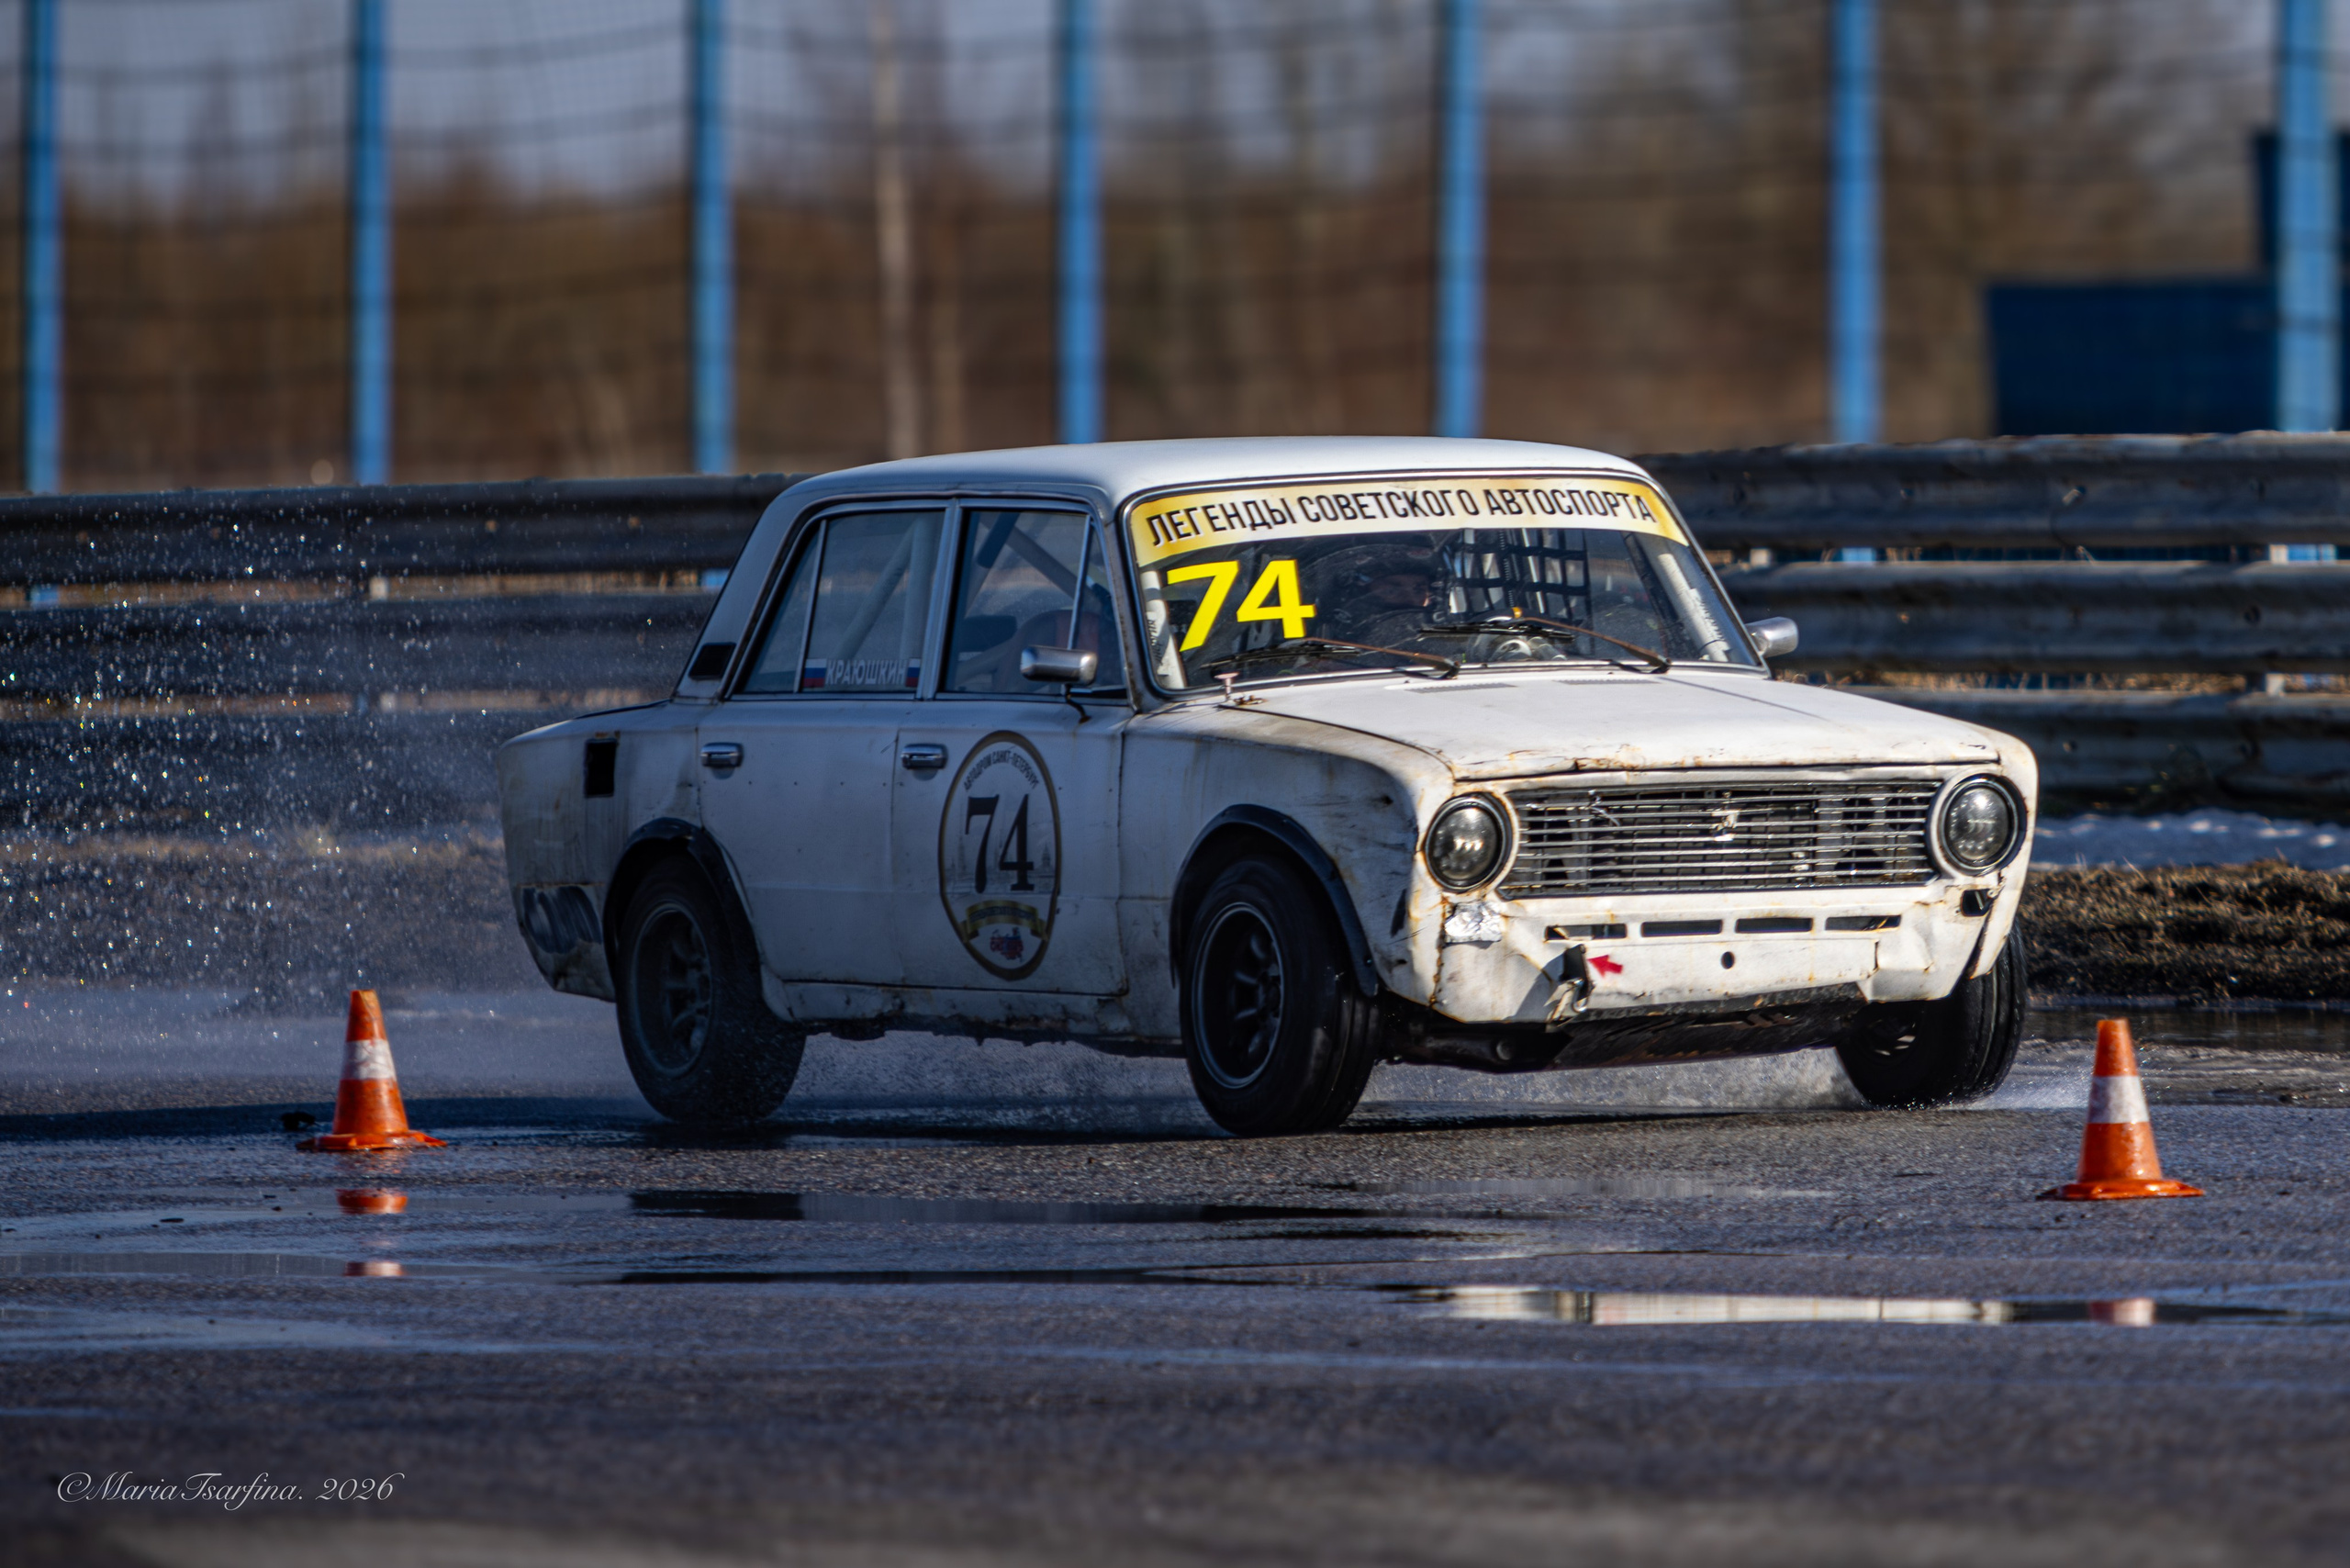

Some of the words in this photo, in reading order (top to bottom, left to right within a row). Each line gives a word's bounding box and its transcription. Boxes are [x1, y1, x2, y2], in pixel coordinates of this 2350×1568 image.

[1147, 497, 1297, 547] ЛЕГЕНДЫ
[1298, 488, 1480, 523] СОВЕТСКОГО
[1483, 488, 1656, 523] АВТОСПОРТА
[1167, 560, 1316, 652] 74
[825, 659, 906, 685] КРАЮШКИН
[965, 794, 1035, 893] 74
